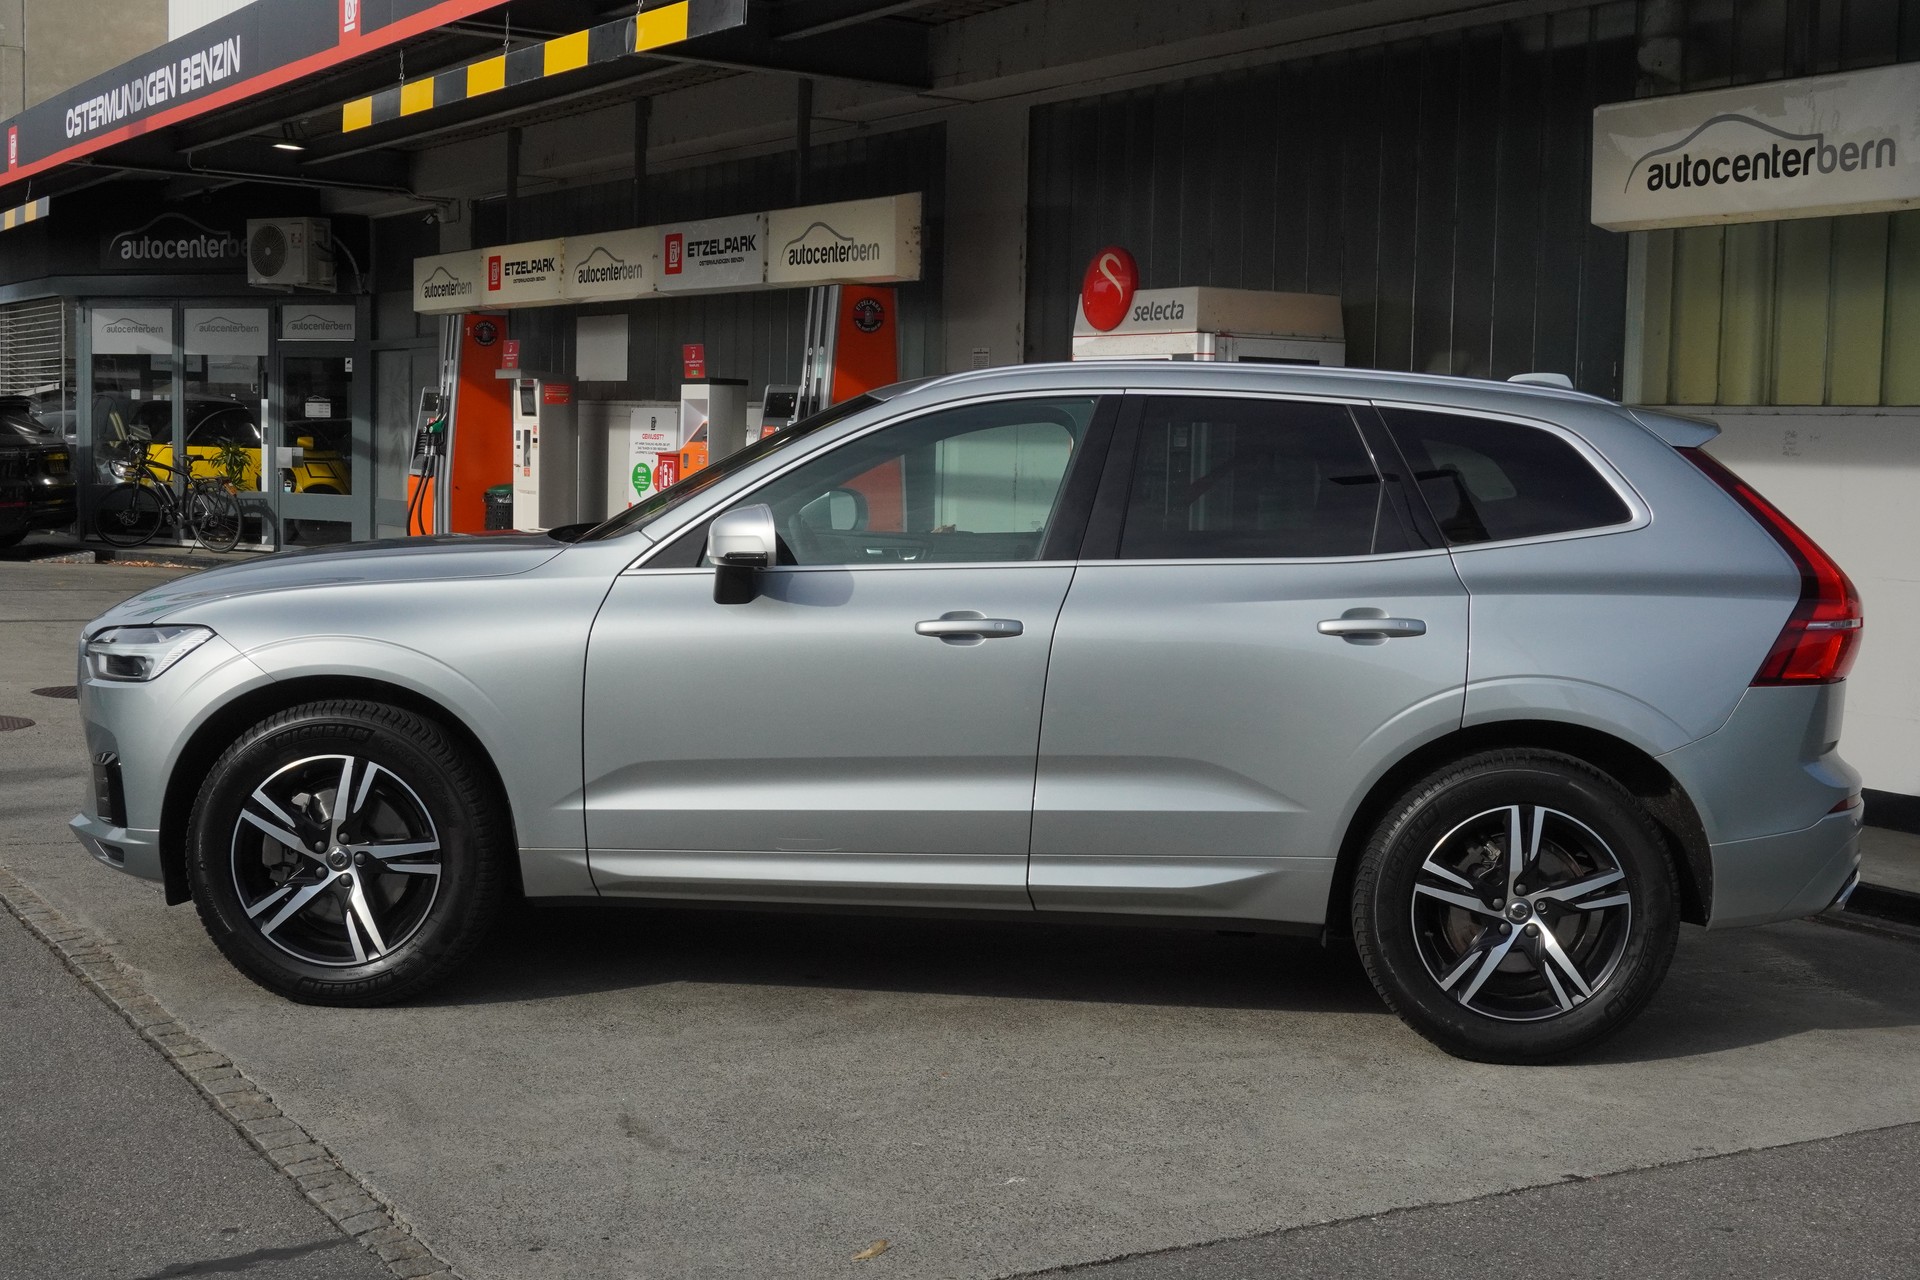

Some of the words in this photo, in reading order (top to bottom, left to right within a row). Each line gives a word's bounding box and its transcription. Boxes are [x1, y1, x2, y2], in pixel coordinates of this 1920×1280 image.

[65, 62, 177, 139] OSTERMUNDIGEN
[180, 35, 241, 95] BENZIN
[1647, 133, 1897, 192] autocenterbern
[120, 234, 248, 260] autocenterbe
[687, 234, 757, 258] ETZELPARK
[788, 238, 880, 266] autocenterbern
[504, 257, 556, 277] ETZELPARK
[578, 261, 643, 284] autocenterbern
[424, 279, 472, 299] autocenterbern
[1133, 300, 1184, 322] selecta
[106, 323, 163, 334] autocenterbern
[198, 323, 259, 334] autocenterbern
[291, 321, 352, 332] autocenterbern
